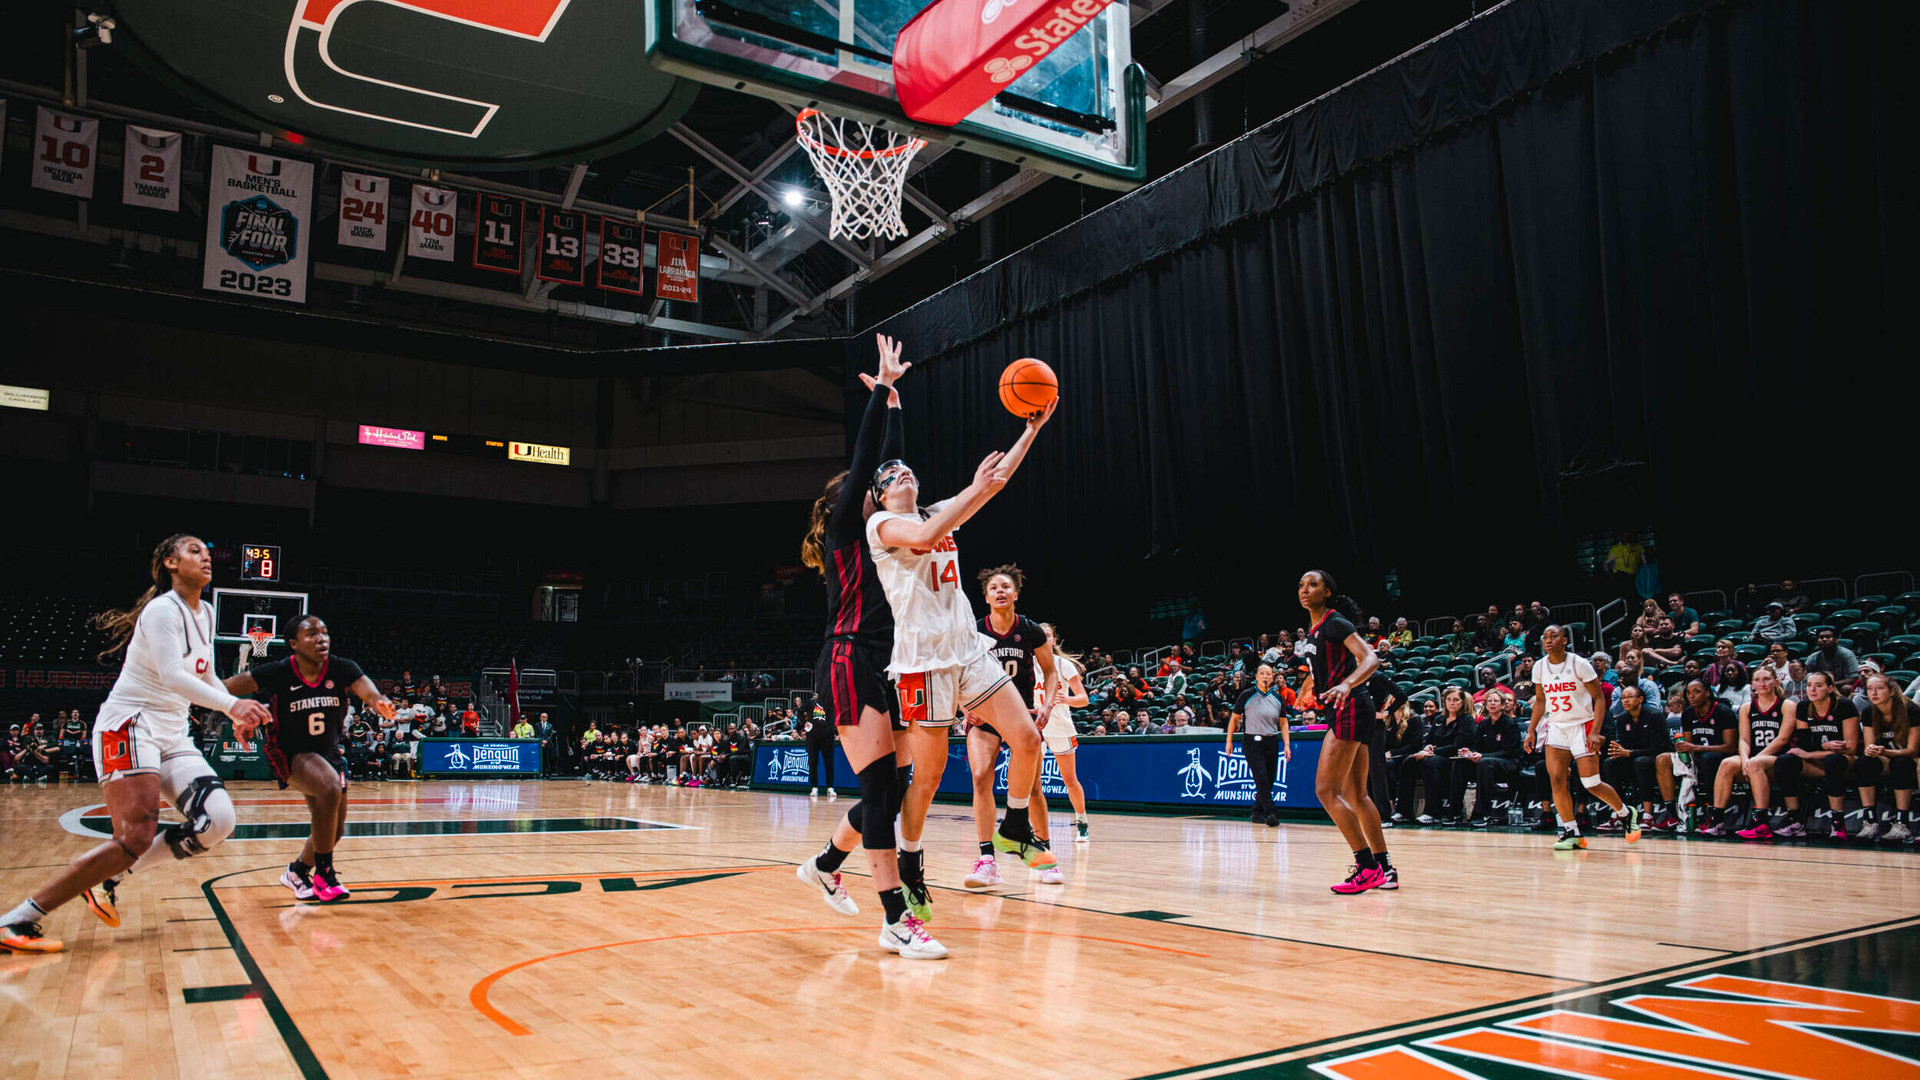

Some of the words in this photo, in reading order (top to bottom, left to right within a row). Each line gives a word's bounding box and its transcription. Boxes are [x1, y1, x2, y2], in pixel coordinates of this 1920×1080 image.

[40, 135, 90, 169] 10
[43, 166, 83, 180] OCTAVIA
[140, 155, 165, 183] 2
[134, 182, 170, 194] TAMARA
[227, 178, 298, 198] BASKETBALL
[245, 173, 281, 188] MEN'S
[342, 197, 384, 225] 24
[235, 211, 285, 235] FINAL
[353, 225, 373, 234] RICK
[411, 209, 454, 237] 40
[238, 228, 288, 252] FOUR
[424, 237, 440, 247] TIM
[484, 219, 515, 247] 11
[419, 242, 444, 251] JAMES
[544, 231, 580, 258] 13
[602, 242, 640, 268] 33
[671, 257, 686, 267] JIM
[219, 269, 292, 297] 2023
[513, 444, 565, 461] UHealth
[245, 548, 270, 560] 43.5
[260, 559, 273, 578] 8
[930, 559, 958, 592] 14
[989, 648, 1024, 660] ANFORD
[1543, 681, 1578, 694] CANES
[289, 696, 340, 713] STANFORD
[1549, 695, 1573, 713] 33
[307, 712, 326, 737] 6
[1751, 720, 1780, 730] STANFORD
[1754, 729, 1776, 748] 22
[472, 748, 519, 765] penguin
